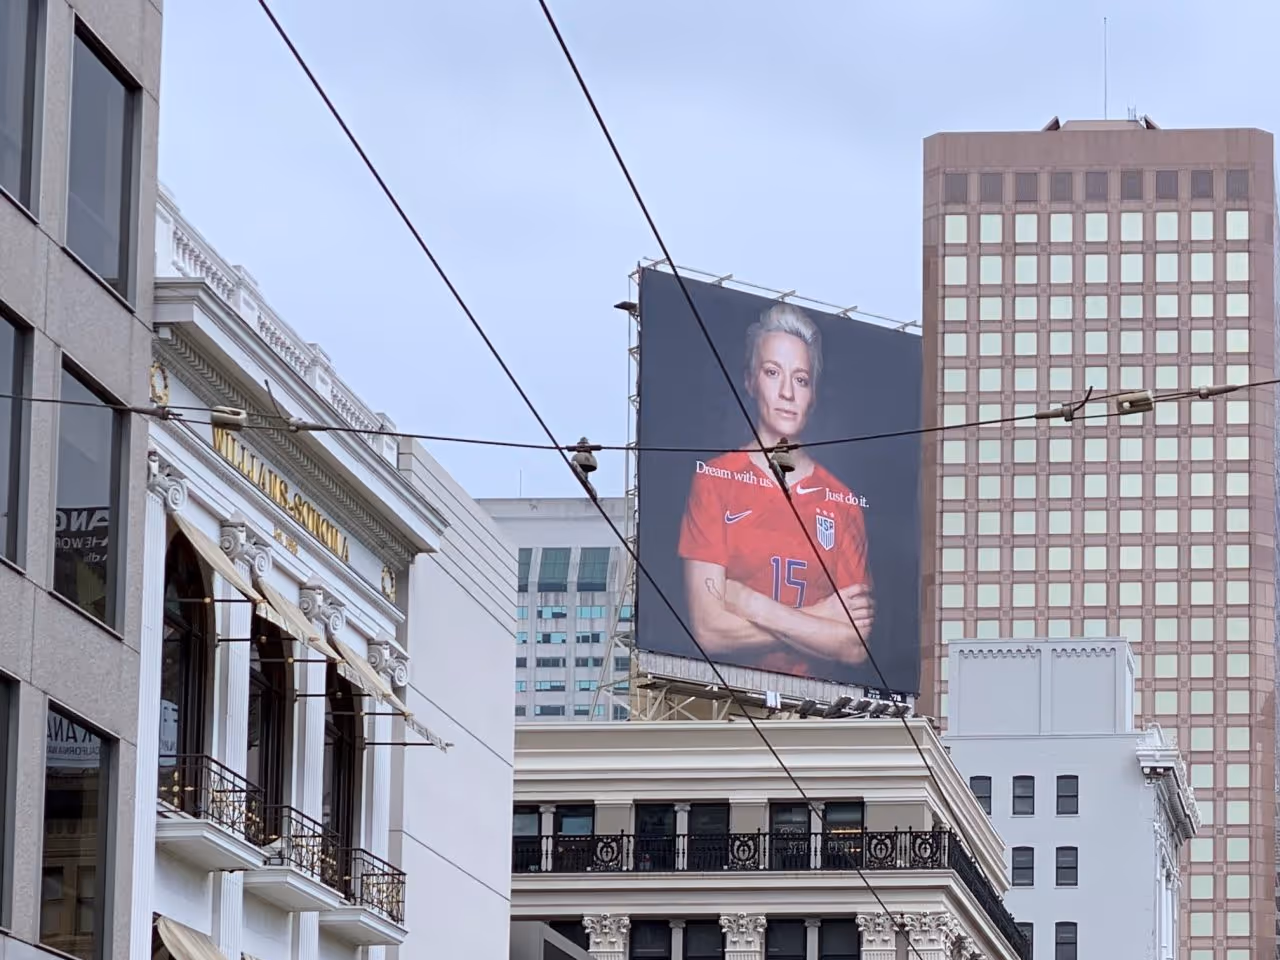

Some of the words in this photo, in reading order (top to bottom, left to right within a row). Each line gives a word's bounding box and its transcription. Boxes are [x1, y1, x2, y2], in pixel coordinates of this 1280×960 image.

[695, 460, 732, 480] Dream
[734, 470, 757, 486] with
[759, 478, 774, 489] us.
[824, 487, 845, 503] Just
[845, 492, 859, 506] do
[859, 494, 870, 508] it.
[816, 515, 834, 532] USA
[771, 556, 808, 609] 15
